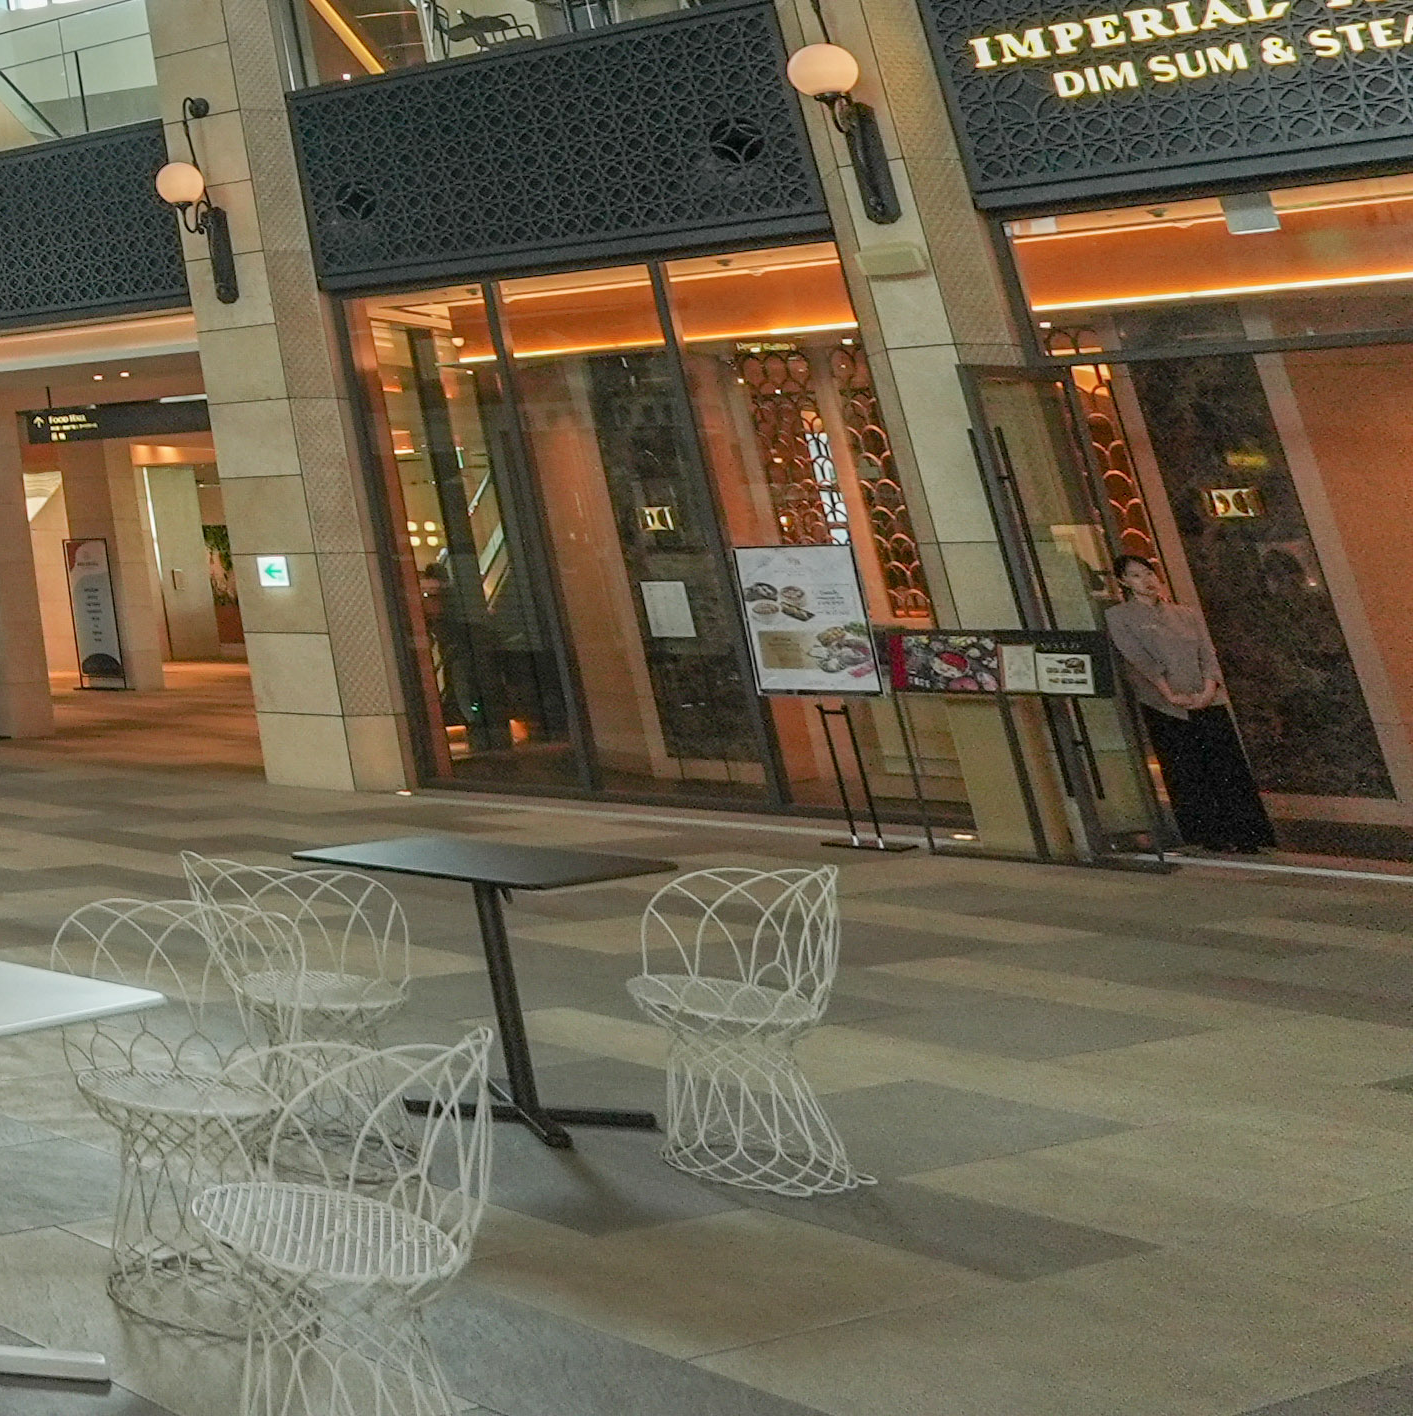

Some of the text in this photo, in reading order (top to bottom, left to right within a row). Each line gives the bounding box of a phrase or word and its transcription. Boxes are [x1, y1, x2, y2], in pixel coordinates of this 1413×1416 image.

[1053, 61, 1140, 98] DIM
[1148, 43, 1249, 83] SUM
[1261, 37, 1297, 66] &
